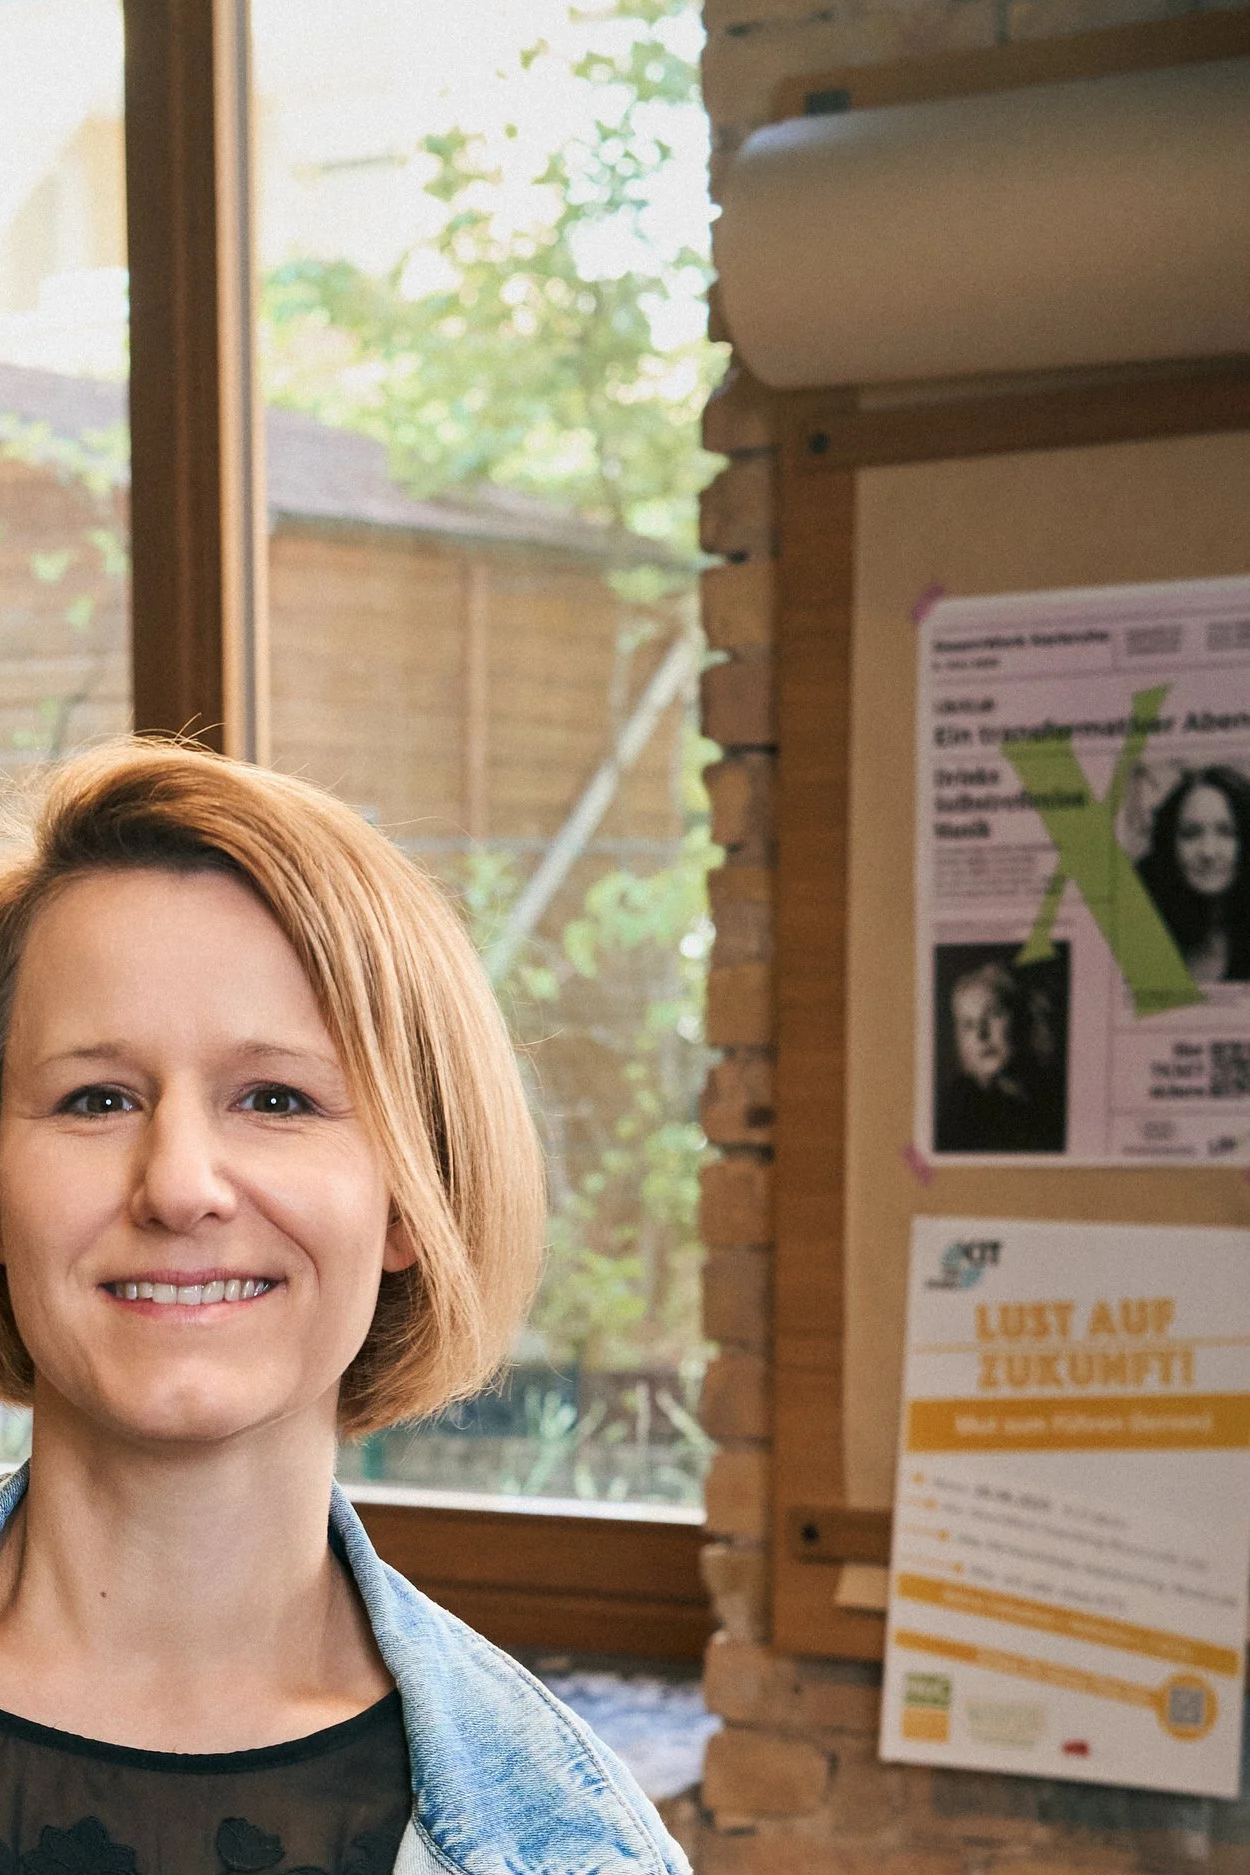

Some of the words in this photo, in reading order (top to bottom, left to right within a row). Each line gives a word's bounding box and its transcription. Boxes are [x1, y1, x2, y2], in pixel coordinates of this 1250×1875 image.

[1182, 710, 1250, 732] Aben
[974, 1302, 1075, 1341] LUST
[1088, 1297, 1177, 1337] AUF
[977, 1349, 1196, 1390] ZUKUNFT!
